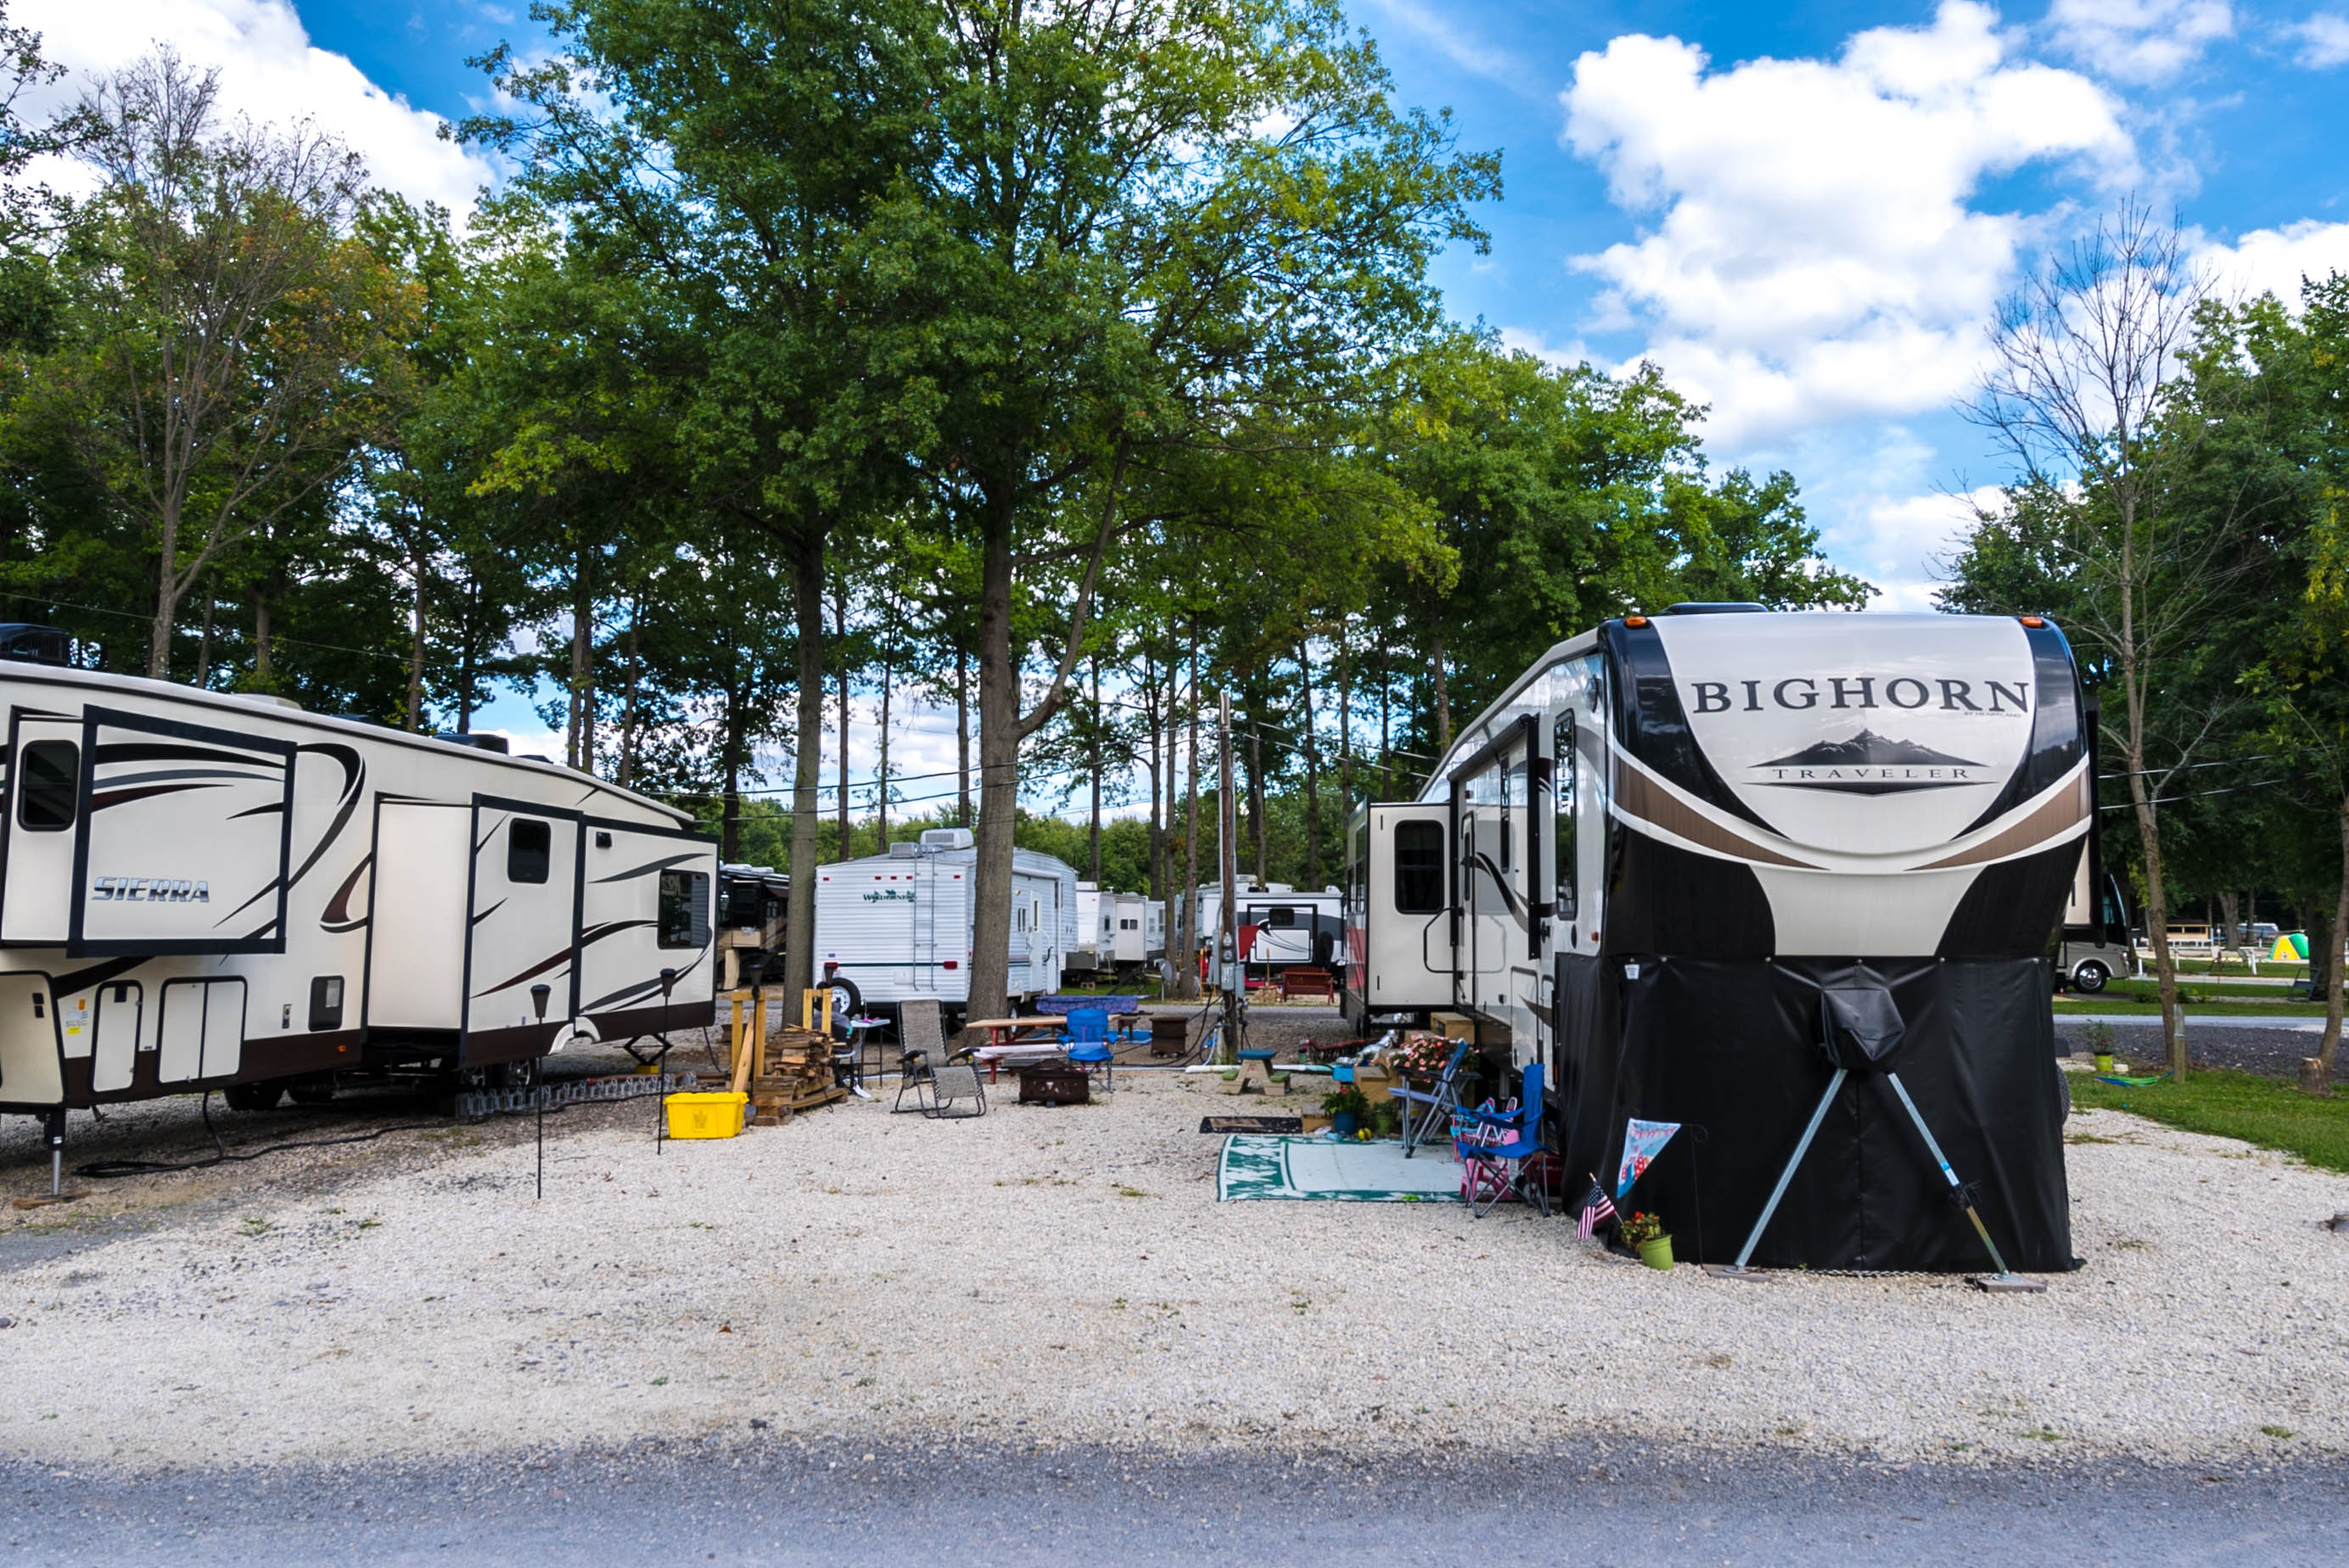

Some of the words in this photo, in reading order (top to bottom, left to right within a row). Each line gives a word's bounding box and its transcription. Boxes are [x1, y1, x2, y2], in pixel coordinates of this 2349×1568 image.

[1691, 678, 2029, 714] BIGHORN
[1772, 768, 1969, 779] TRAVELER
[91, 876, 210, 903] SIERRA
